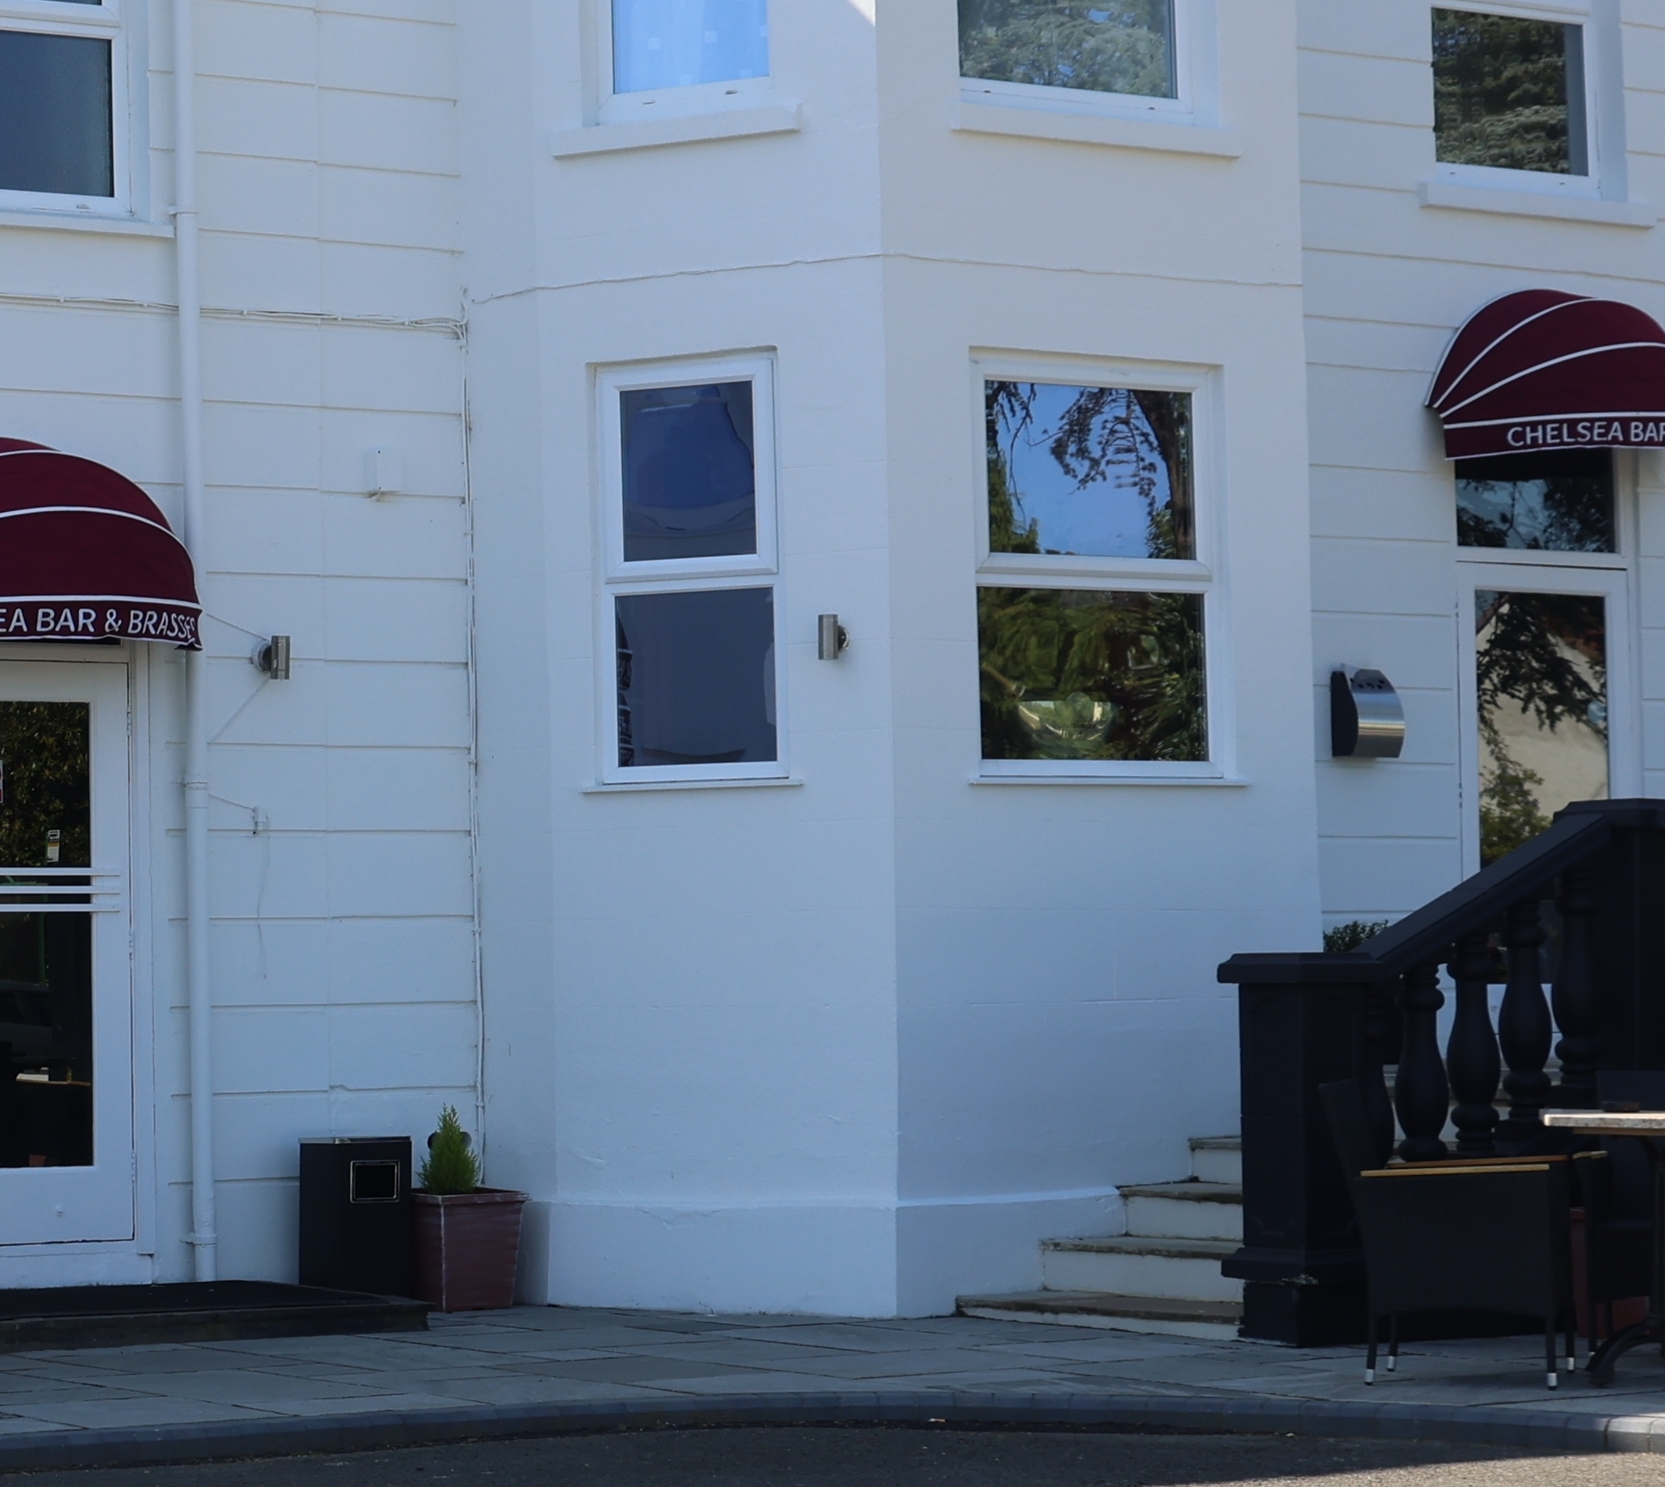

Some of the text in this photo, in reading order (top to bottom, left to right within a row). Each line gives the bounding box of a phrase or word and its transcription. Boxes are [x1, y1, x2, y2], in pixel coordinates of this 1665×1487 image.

[1506, 421, 1624, 447] CHELSEA
[35, 608, 97, 633] BAR
[104, 609, 122, 633] &
